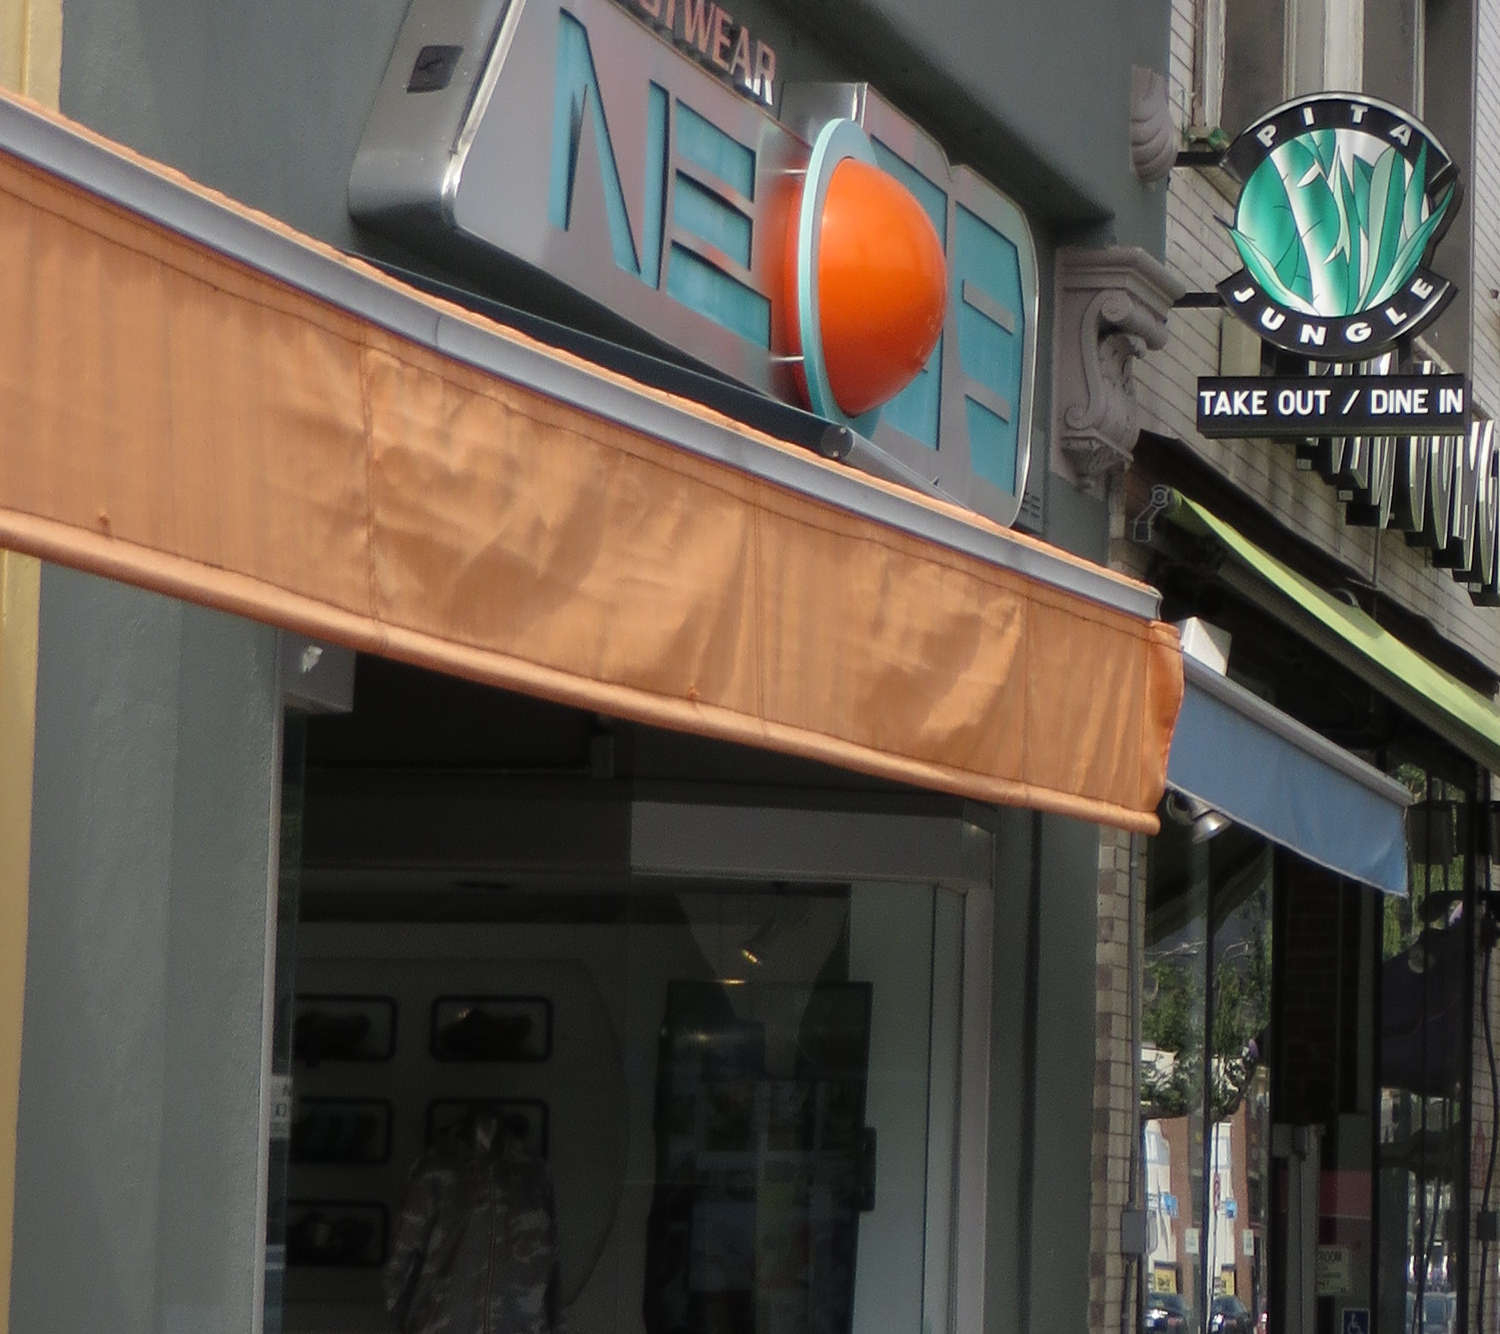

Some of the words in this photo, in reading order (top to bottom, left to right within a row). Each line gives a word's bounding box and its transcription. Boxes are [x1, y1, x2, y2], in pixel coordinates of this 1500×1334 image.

[1255, 104, 1413, 149] PITA
[1233, 277, 1434, 346] JUNGLE
[1200, 390, 1268, 416] TAKE
[1277, 390, 1331, 415] OUT
[1370, 389, 1429, 414] DINE
[1439, 388, 1464, 414] IN
